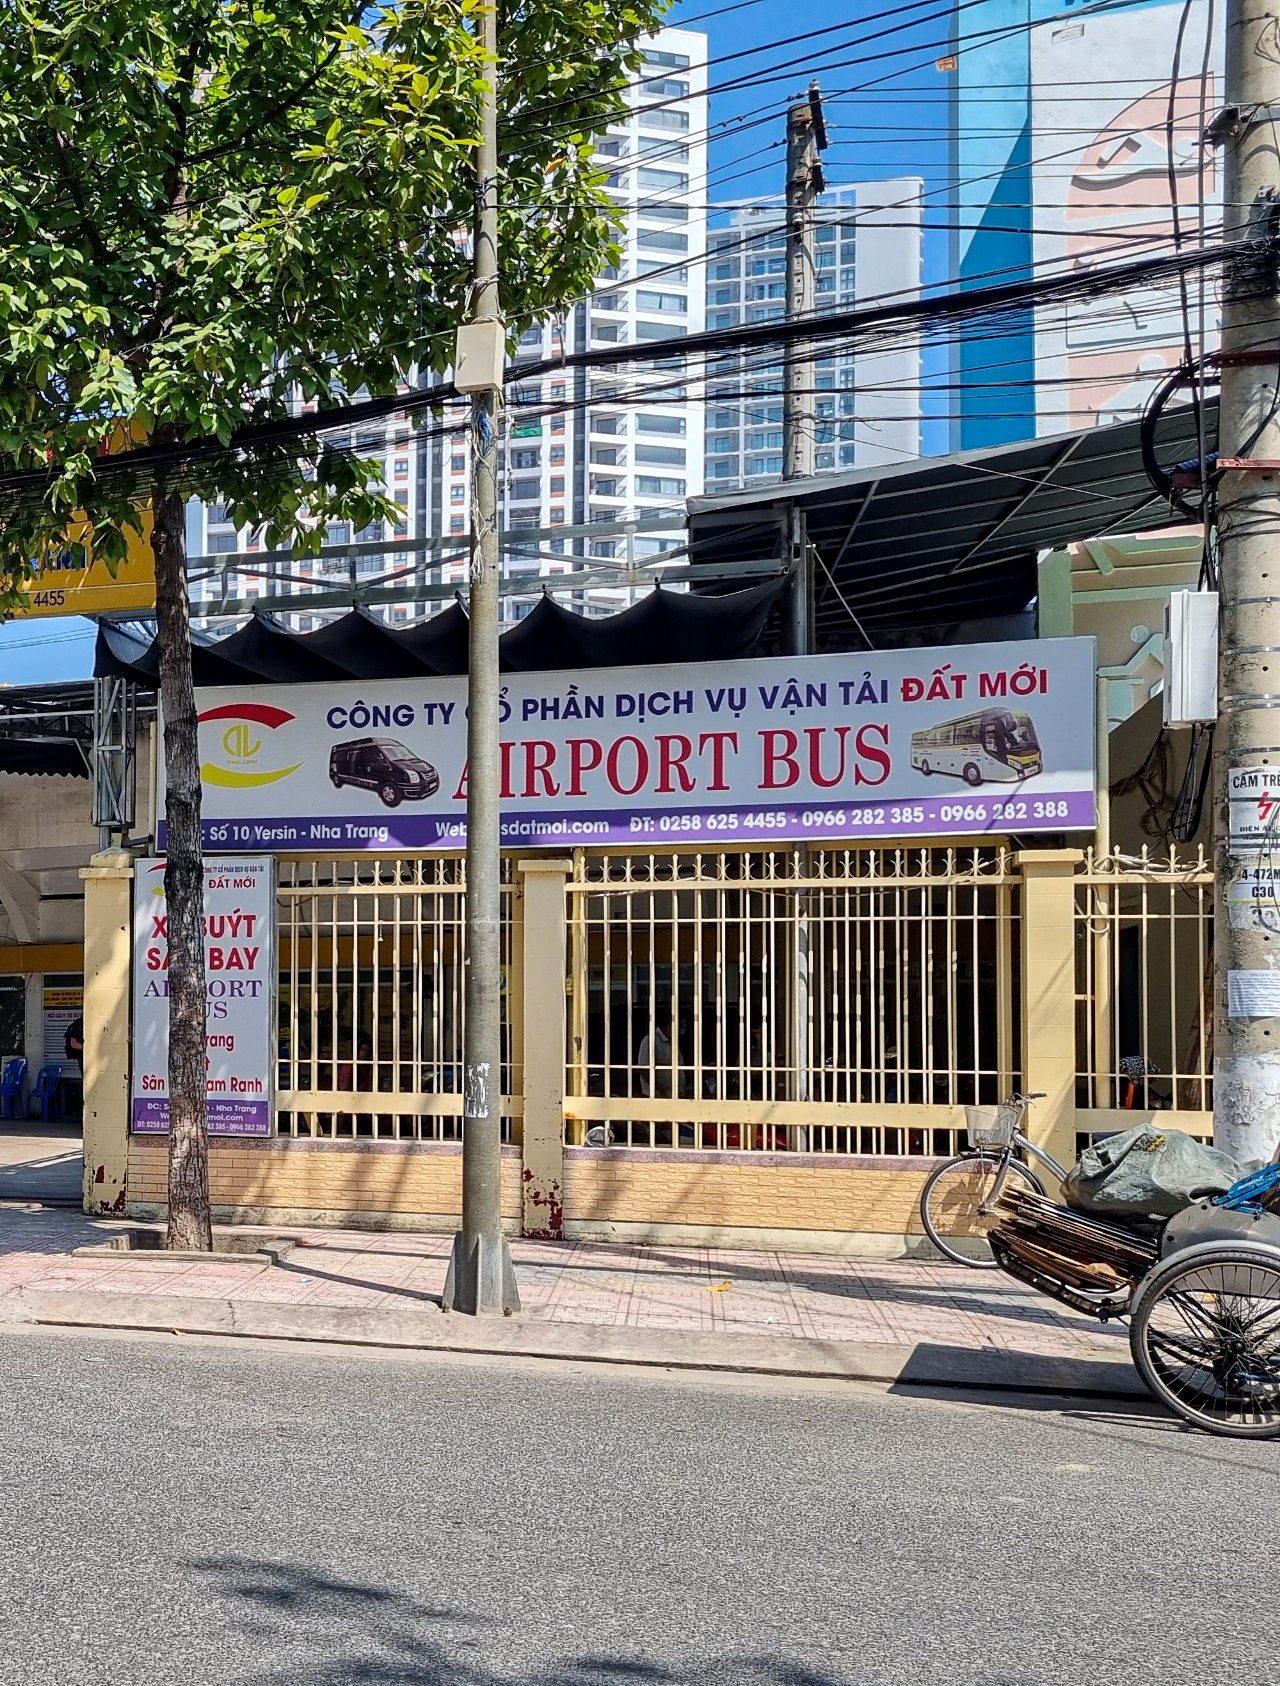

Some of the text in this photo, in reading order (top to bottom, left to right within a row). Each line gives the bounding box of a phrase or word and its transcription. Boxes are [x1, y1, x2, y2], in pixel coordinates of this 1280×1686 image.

[34, 590, 64, 607] 4455
[326, 663, 1049, 729] CÔNG TY Ổ PHẦN DỊCH VỤ VẬN TẢI ĐẤT MỚI
[757, 723, 892, 790] BUS
[209, 823, 230, 841] Số
[232, 826, 249, 841] 10
[253, 825, 297, 841] Yersin
[310, 824, 341, 839] Nha
[345, 823, 389, 842] Trang
[500, 818, 609, 836] sdatmoi.com
[630, 817, 656, 833] ĐT:
[659, 814, 702, 831] 0258
[706, 812, 739, 830] 625
[743, 810, 787, 828] 4455
[802, 809, 847, 827] 0966
[851, 807, 885, 825] 282
[890, 806, 924, 823] 385
[939, 804, 987, 822] 0966
[992, 802, 1027, 820] 282
[1032, 801, 1069, 819] 388
[208, 875, 256, 888] ĐẤT MỚI
[209, 947, 259, 971] BAY
[144, 979, 263, 998] AIORT
[205, 1034, 235, 1052] rang
[142, 1074, 263, 1093] Sân am Ranh
[216, 1104, 233, 1112] Nha
[234, 1104, 257, 1114] Trang
